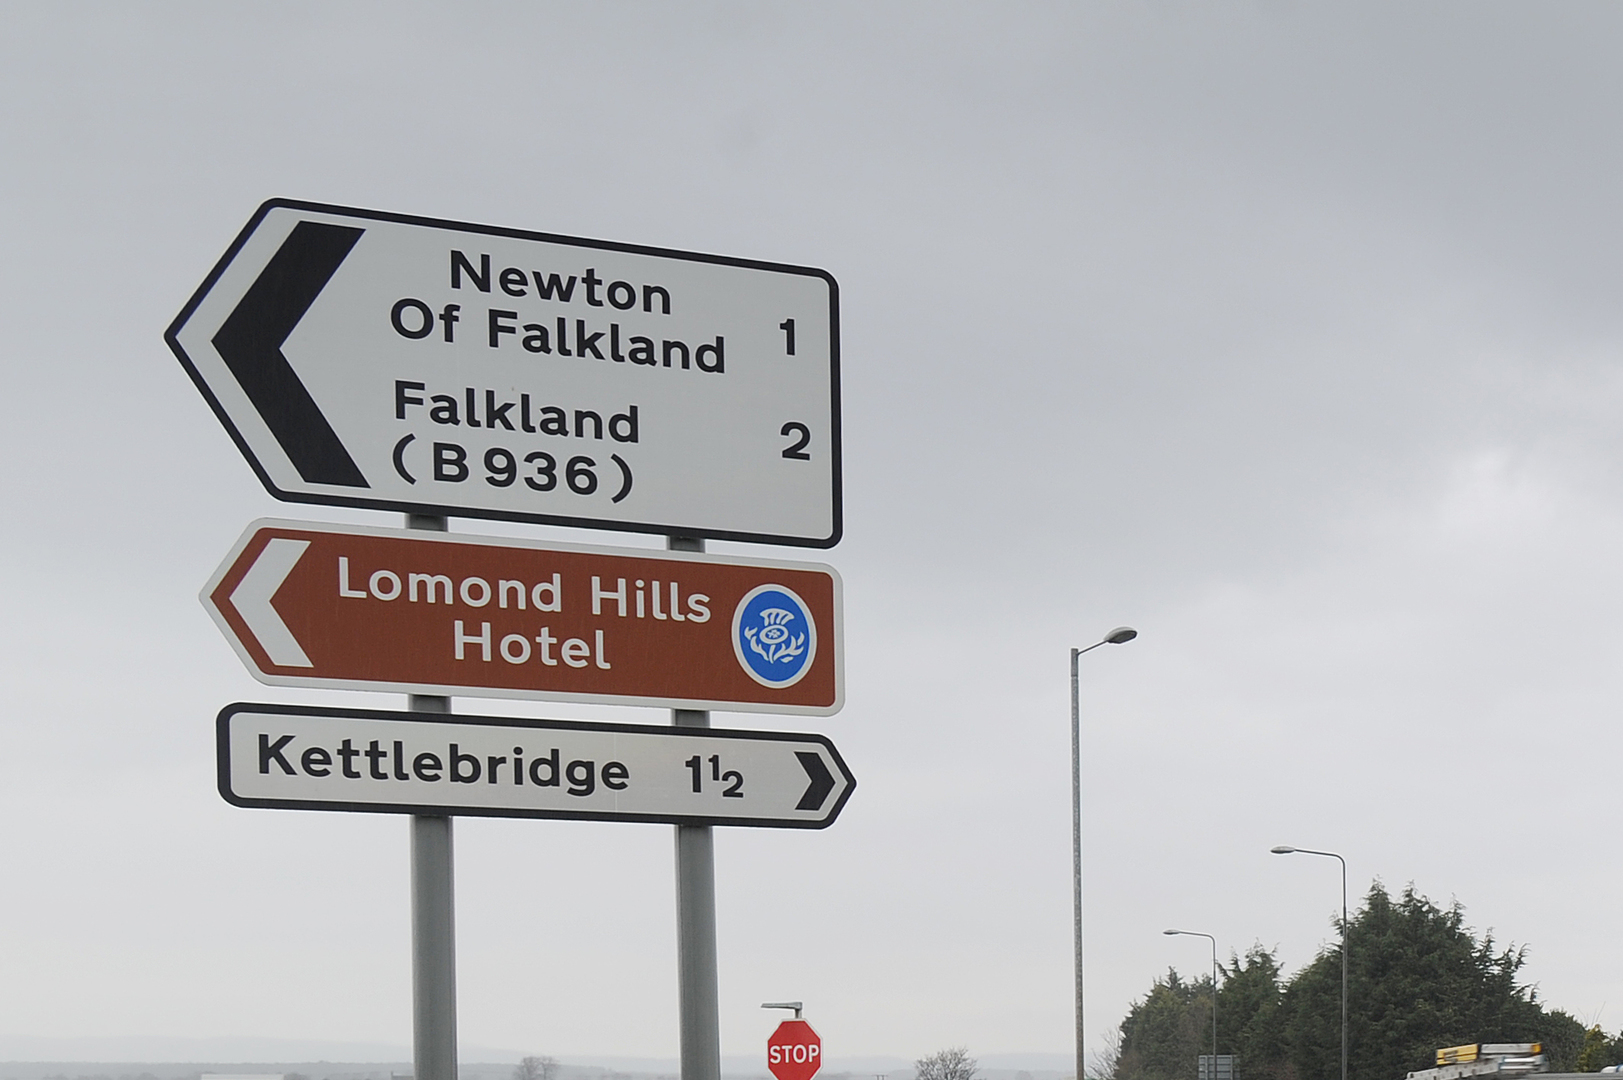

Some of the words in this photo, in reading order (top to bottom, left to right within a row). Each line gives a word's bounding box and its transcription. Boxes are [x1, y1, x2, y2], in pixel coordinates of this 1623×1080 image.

[451, 250, 671, 315] Newton
[391, 298, 461, 343] Of
[489, 308, 725, 374] Falkland
[780, 318, 796, 356] 1
[395, 379, 639, 444] Falkland
[781, 421, 811, 461] 2
[338, 556, 562, 613] Lomond
[591, 575, 711, 623] Hills
[454, 619, 612, 670] Hotel
[258, 733, 630, 797] Kettlebridge
[769, 1044, 820, 1064] STOP
